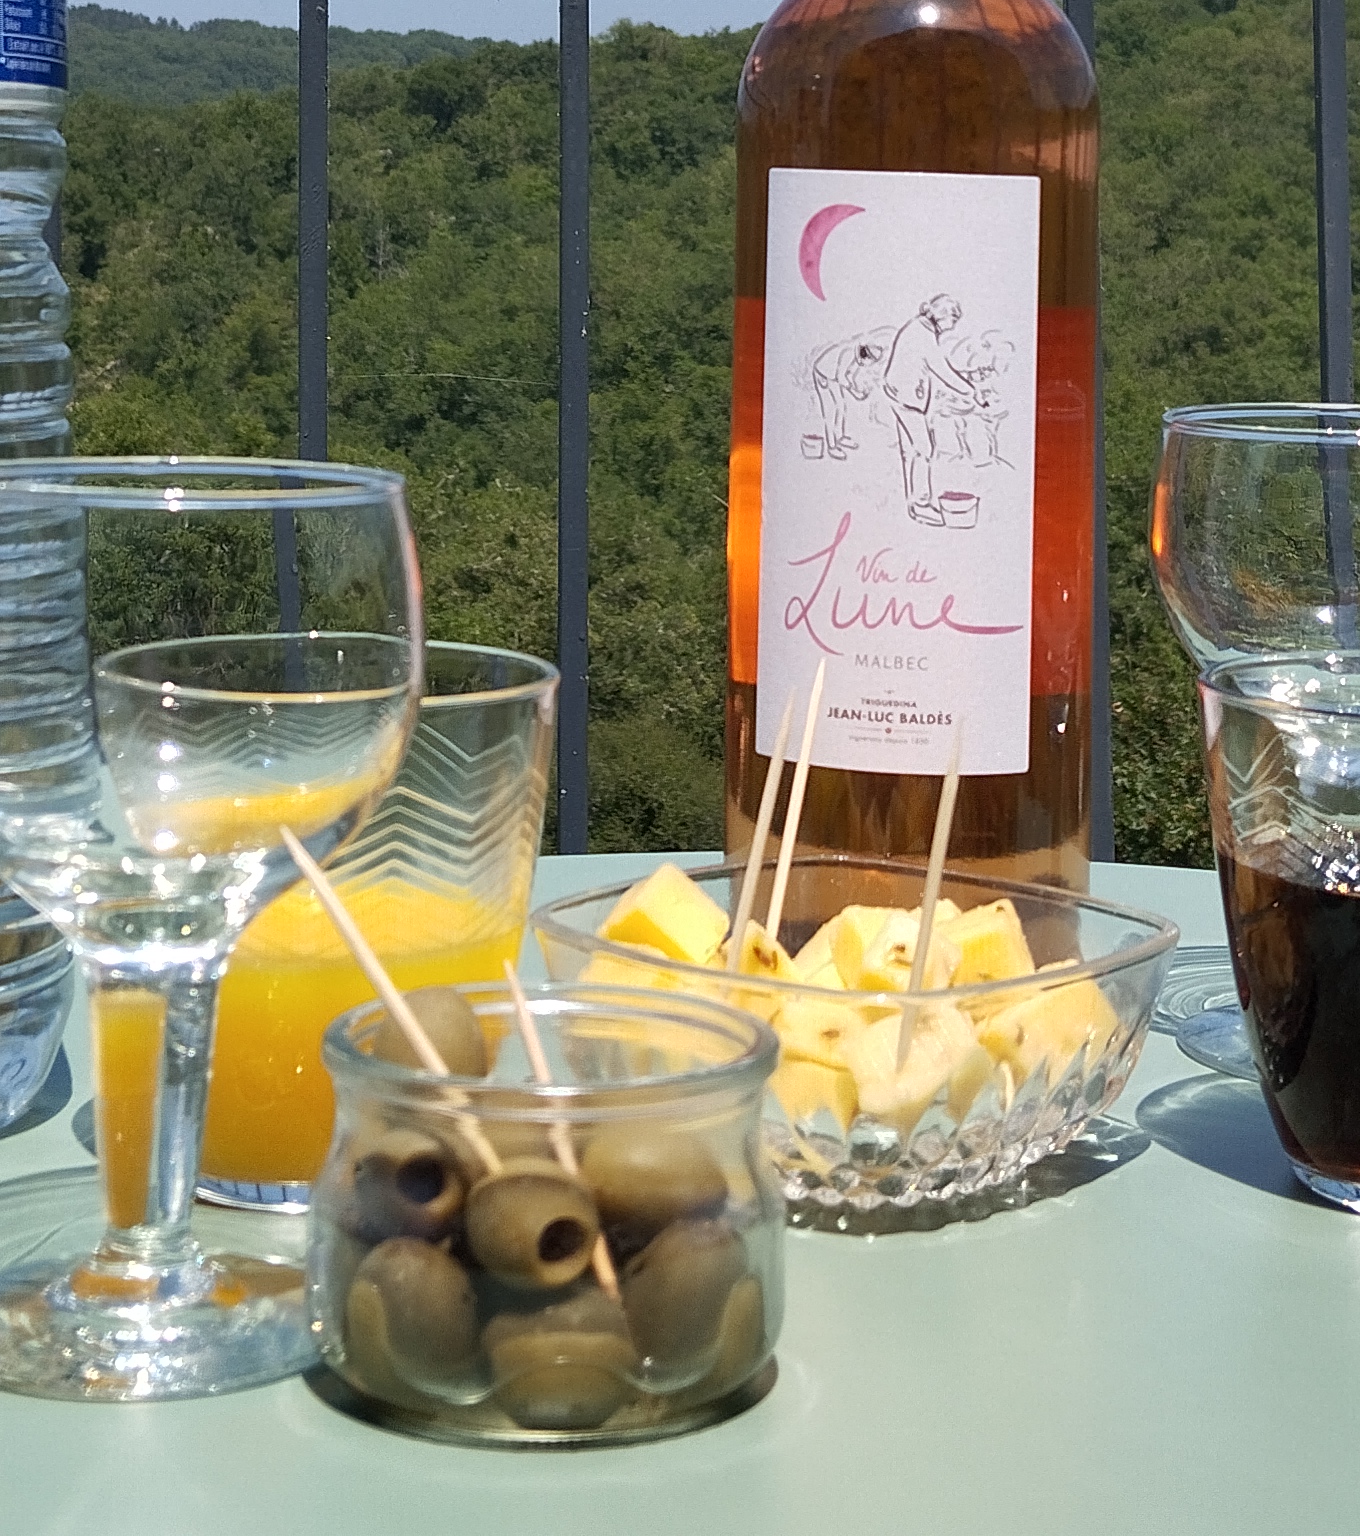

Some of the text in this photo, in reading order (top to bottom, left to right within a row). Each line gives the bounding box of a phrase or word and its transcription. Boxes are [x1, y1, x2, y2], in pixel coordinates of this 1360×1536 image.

[905, 560, 937, 583] de
[784, 511, 1024, 655] Lune
[854, 654, 929, 671] MALBEC
[827, 707, 894, 723] JEAN-LUC
